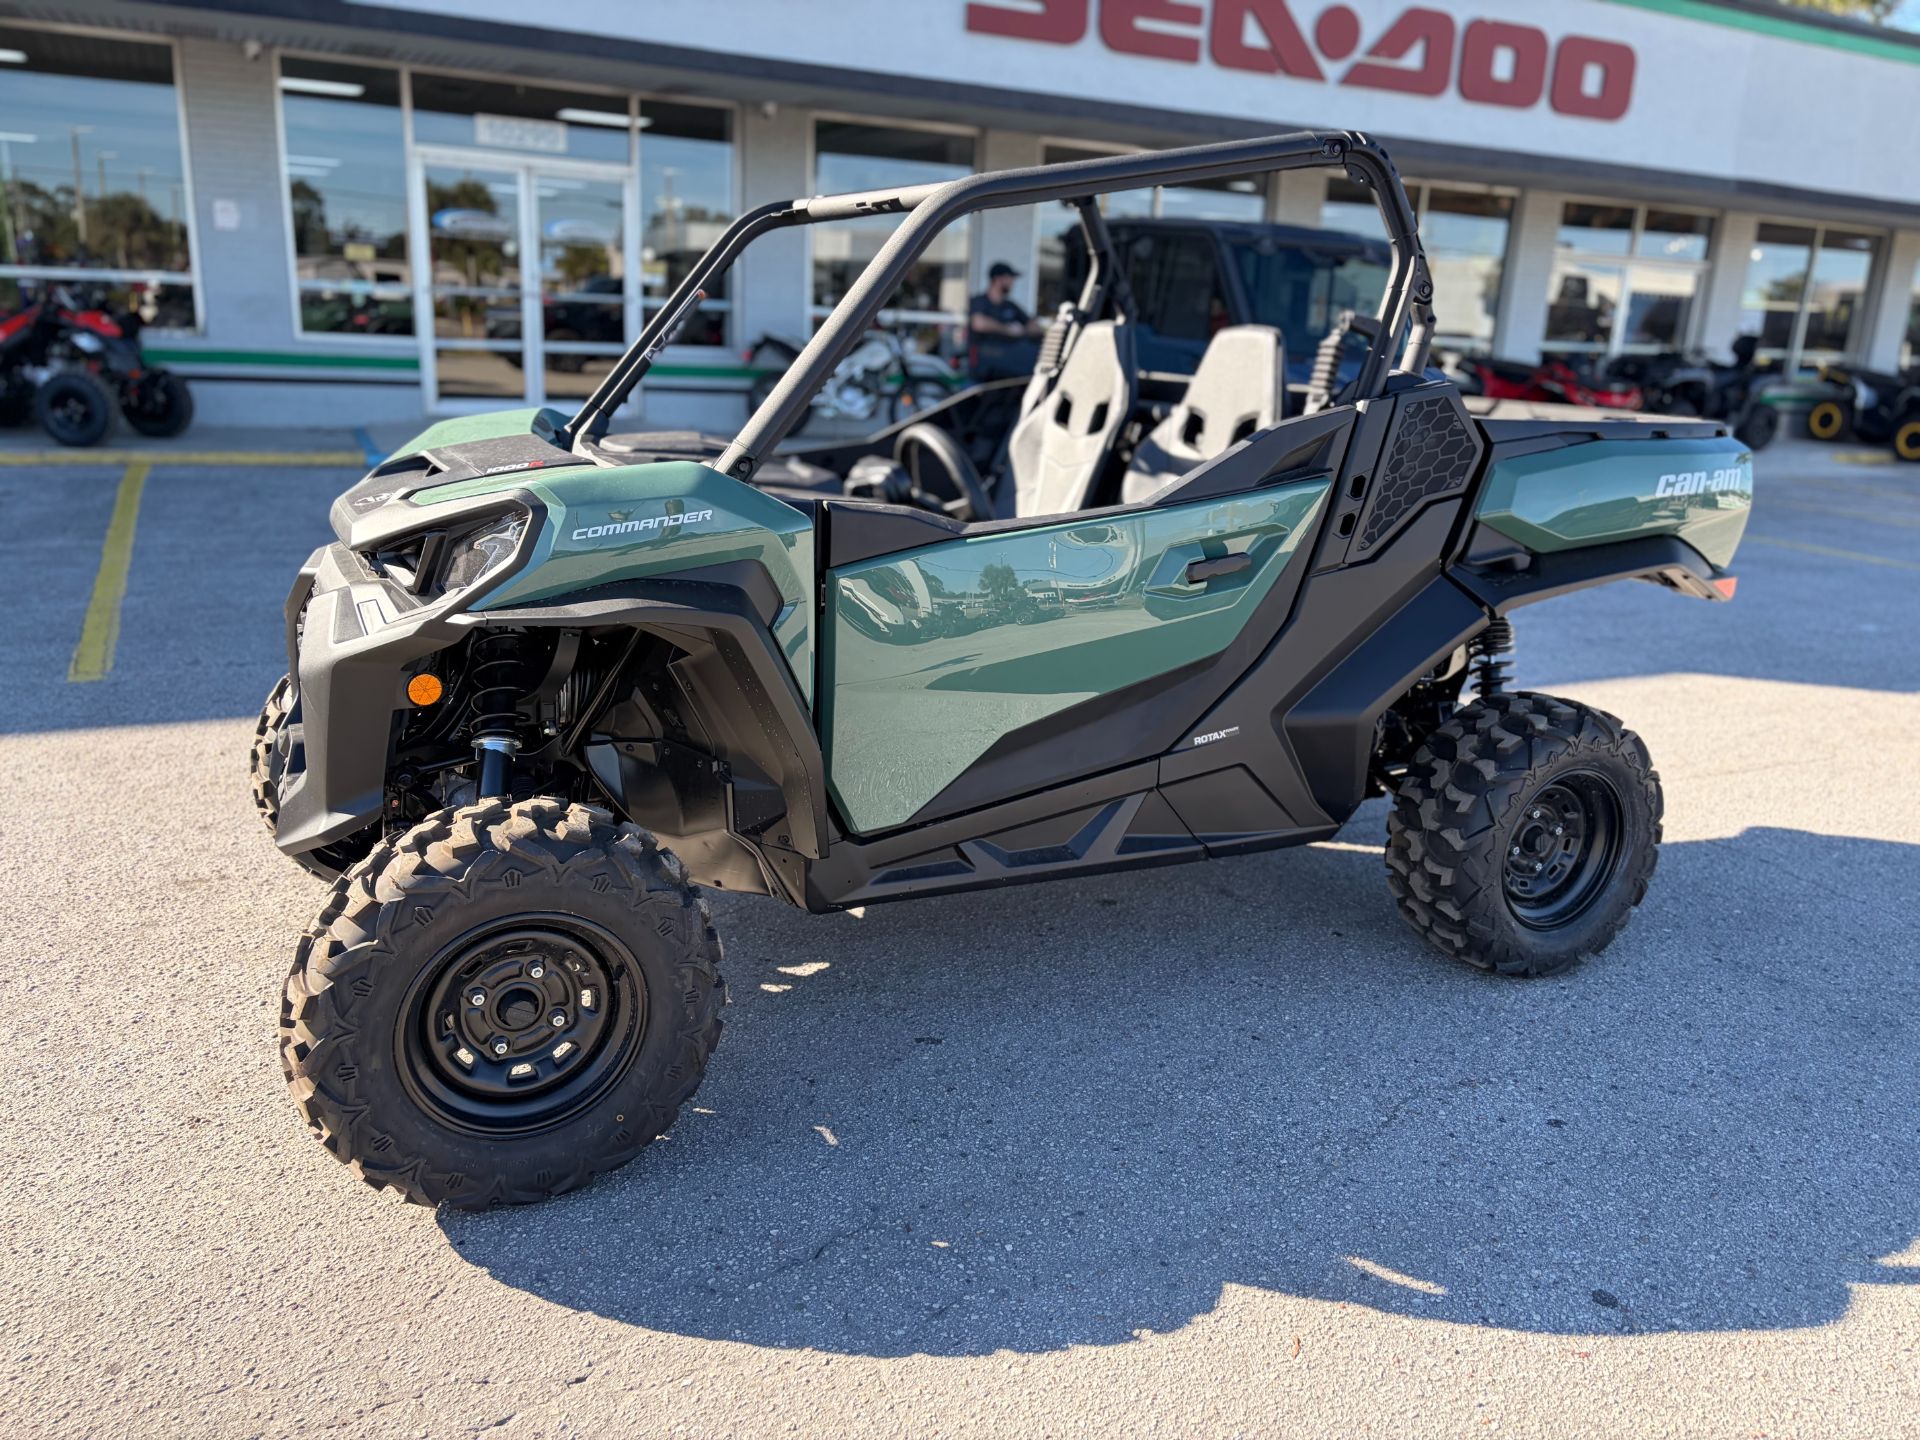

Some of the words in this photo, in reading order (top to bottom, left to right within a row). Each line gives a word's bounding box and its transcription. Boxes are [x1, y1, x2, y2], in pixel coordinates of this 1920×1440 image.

[486, 460, 544, 474] 1000R
[572, 509, 713, 541] COMMANDER
[1193, 729, 1227, 745] ROTAX
